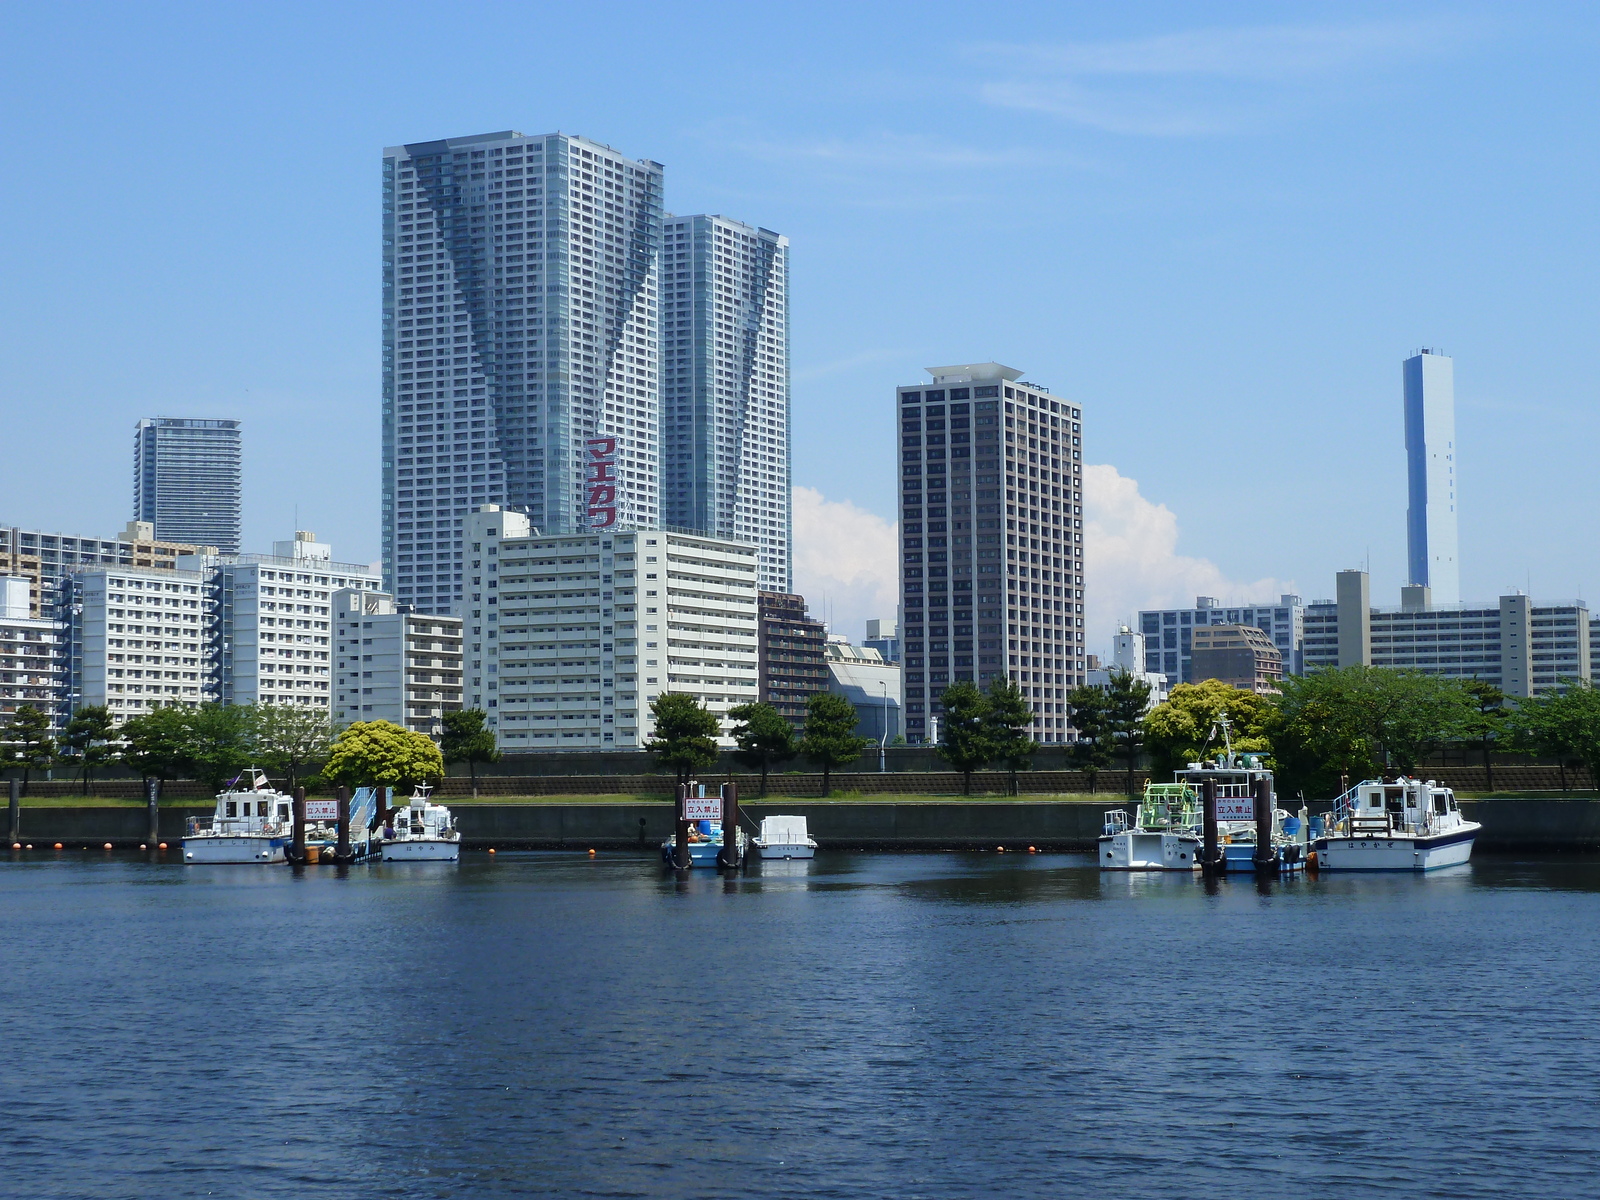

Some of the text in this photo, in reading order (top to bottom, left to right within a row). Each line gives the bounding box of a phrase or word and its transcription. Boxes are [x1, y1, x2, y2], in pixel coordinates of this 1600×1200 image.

[587, 438, 616, 528] マエカワ
[688, 806, 720, 814] 立入禁止
[1218, 806, 1252, 814] 立入禁止
